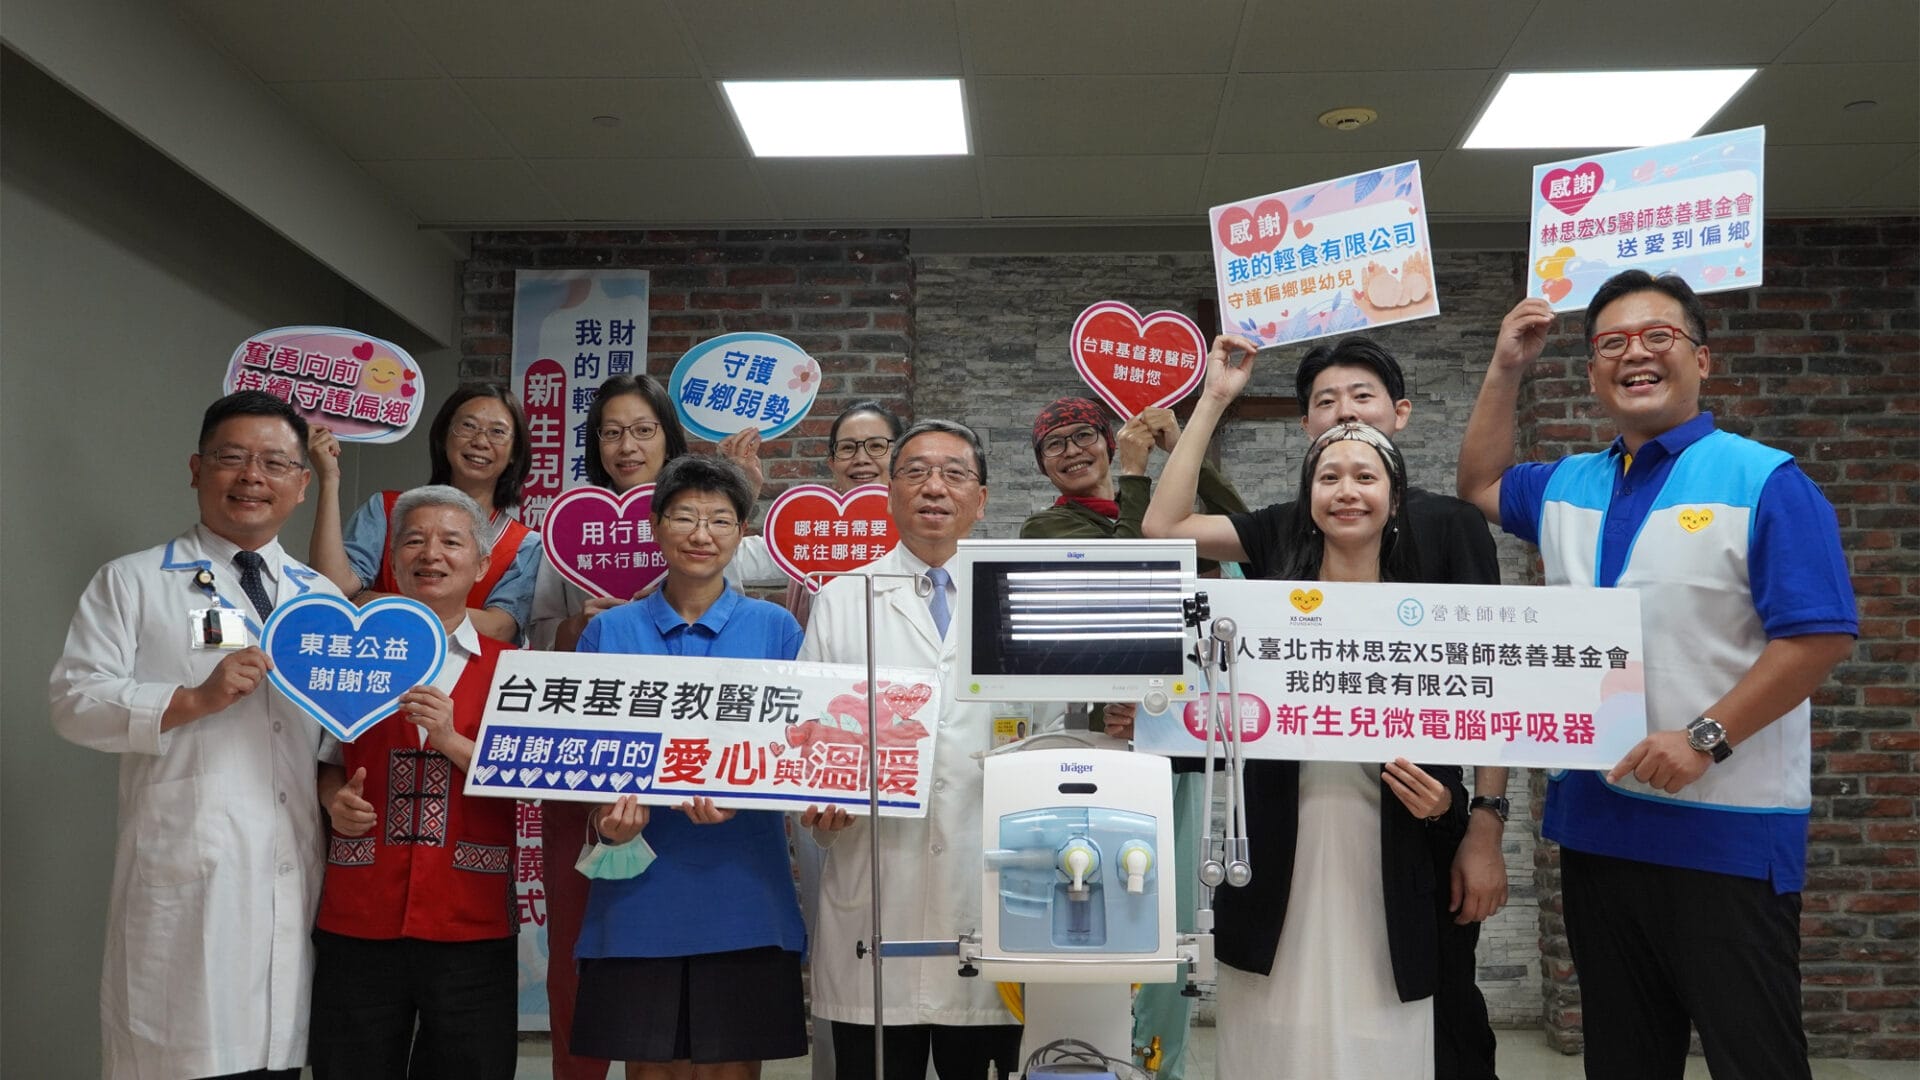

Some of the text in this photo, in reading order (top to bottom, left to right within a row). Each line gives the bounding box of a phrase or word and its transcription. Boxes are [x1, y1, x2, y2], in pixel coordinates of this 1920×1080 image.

[1549, 171, 1596, 200] 感謝
[1229, 212, 1281, 245] 感謝
[1541, 192, 1753, 244] 林思宏X5醫師慈善基金會
[1228, 222, 1416, 283] 我的輕食有限公司
[1617, 221, 1750, 259] 送愛到偏鄉
[1228, 269, 1355, 310] 守護偏鄉嬰幼兒
[243, 340, 361, 386] 奮勇向前
[723, 351, 778, 386] 守護
[1082, 336, 1197, 369] 台東基督教醫院
[1113, 364, 1162, 386] 謝謝您
[235, 370, 412, 426] 持續守護偏鄉
[681, 377, 791, 425] 偏鄉弱勢
[794, 520, 888, 537] 哪裡有需要
[577, 551, 668, 570] 幫不行動的
[793, 544, 887, 560] 就往哪裡去
[1432, 603, 1539, 624] 營養師輕食
[299, 633, 409, 661] 東基公益
[308, 667, 392, 694] 謝謝您
[1286, 671, 1494, 698] 我的輕食有限公司
[496, 674, 803, 724] 台東基督教醫院
[1277, 703, 1596, 745] 新生兒微電腦呼吸器
[487, 734, 655, 768] 謝謝您們的
[1060, 762, 1093, 774] Dräger
